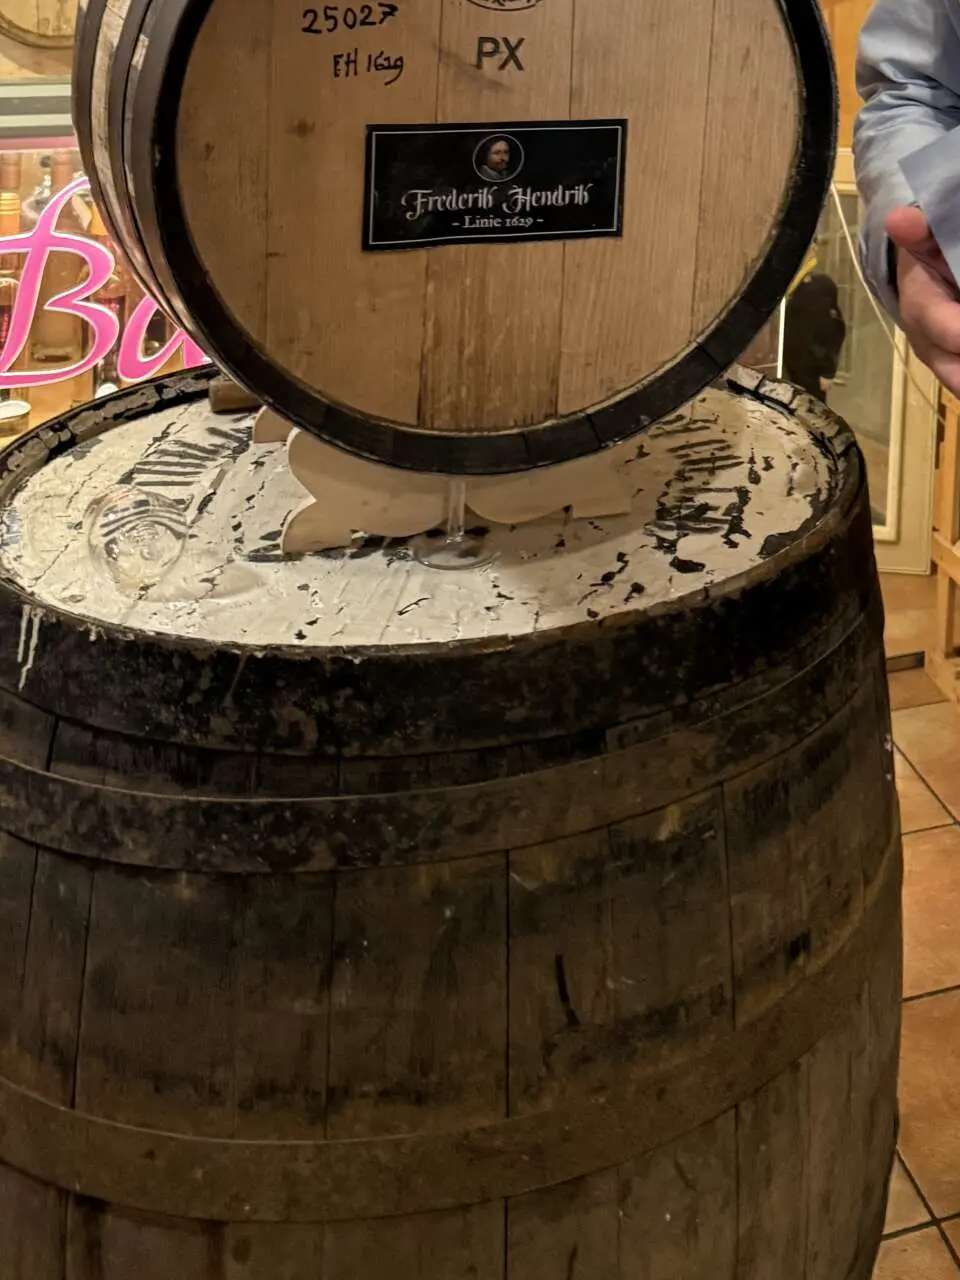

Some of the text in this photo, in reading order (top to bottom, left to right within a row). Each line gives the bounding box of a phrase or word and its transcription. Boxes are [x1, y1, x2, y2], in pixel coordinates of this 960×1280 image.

[476, 36, 526, 71] PX
[401, 183, 594, 221] Frederik Hendrik
[462, 214, 533, 229] Linie 1629
